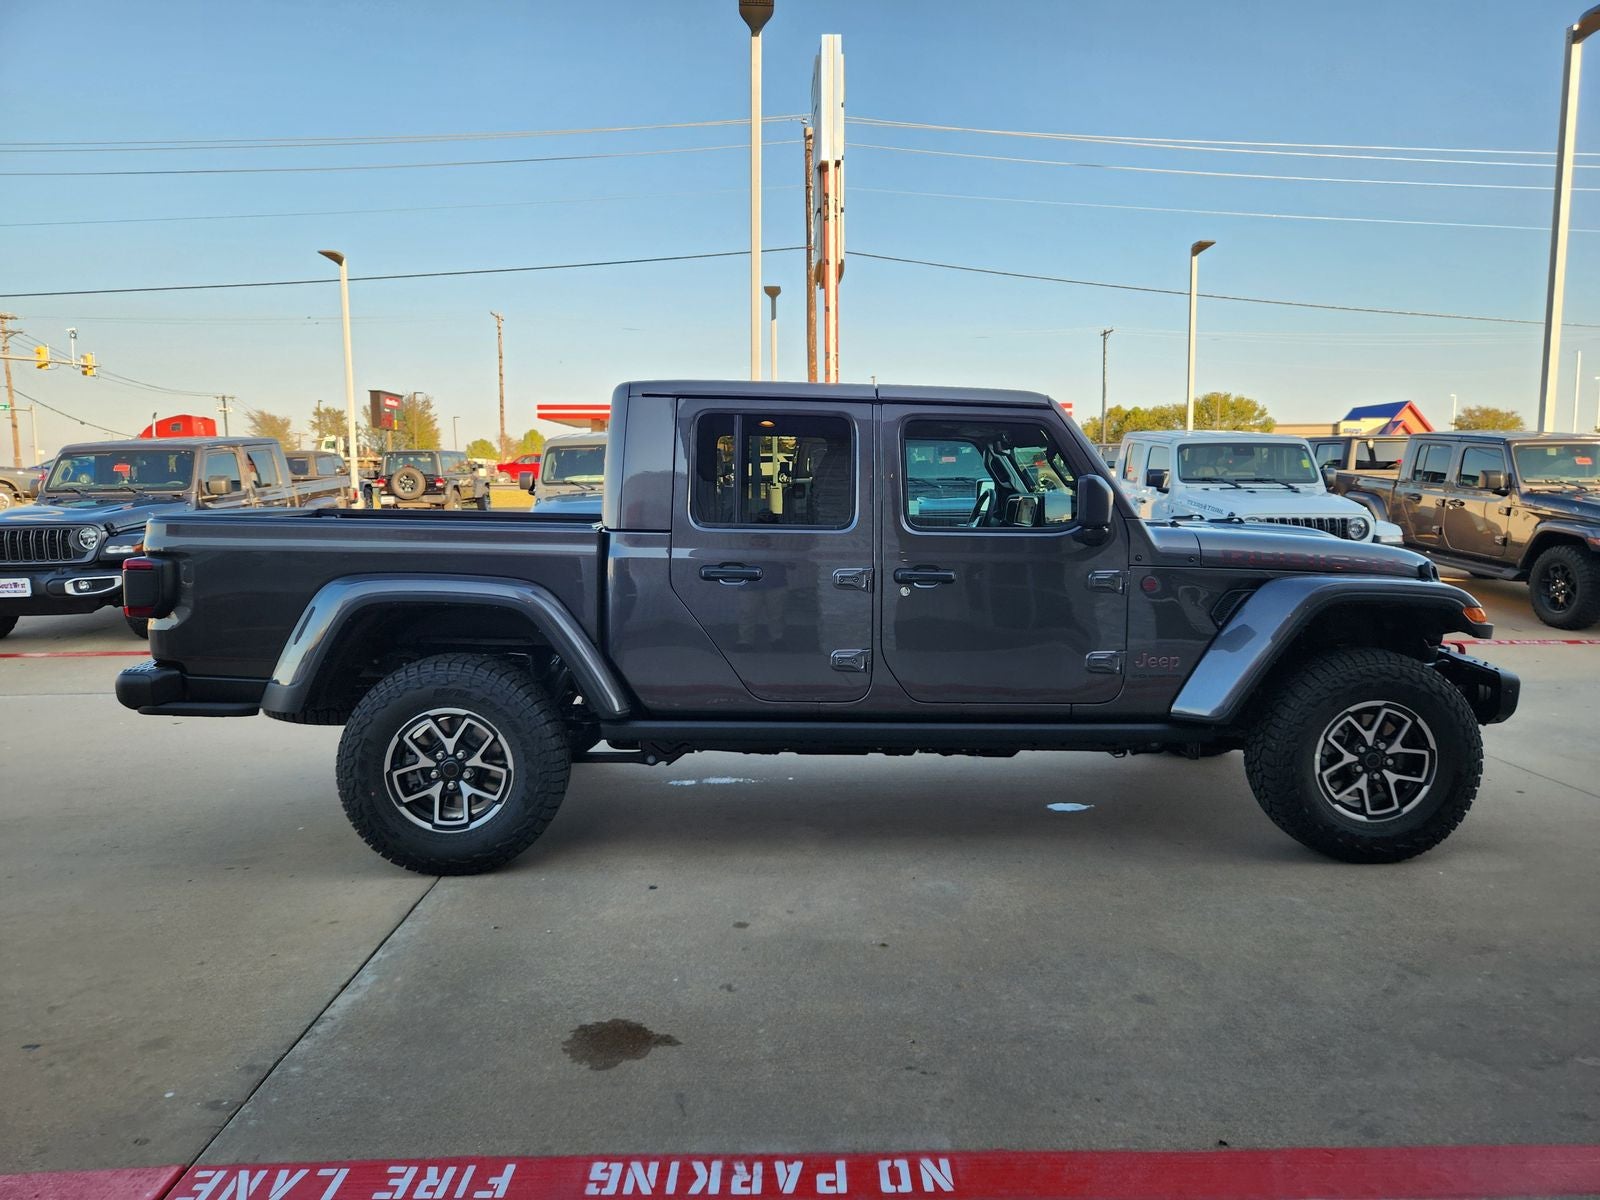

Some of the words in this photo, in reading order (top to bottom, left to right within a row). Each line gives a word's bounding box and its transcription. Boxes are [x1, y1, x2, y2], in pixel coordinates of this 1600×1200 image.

[1135, 652, 1180, 672] Jeep
[173, 1168, 350, 1200] LANE
[372, 1163, 517, 1200] FIRE
[584, 1159, 848, 1196] PARKING
[878, 1158, 955, 1193] NO
